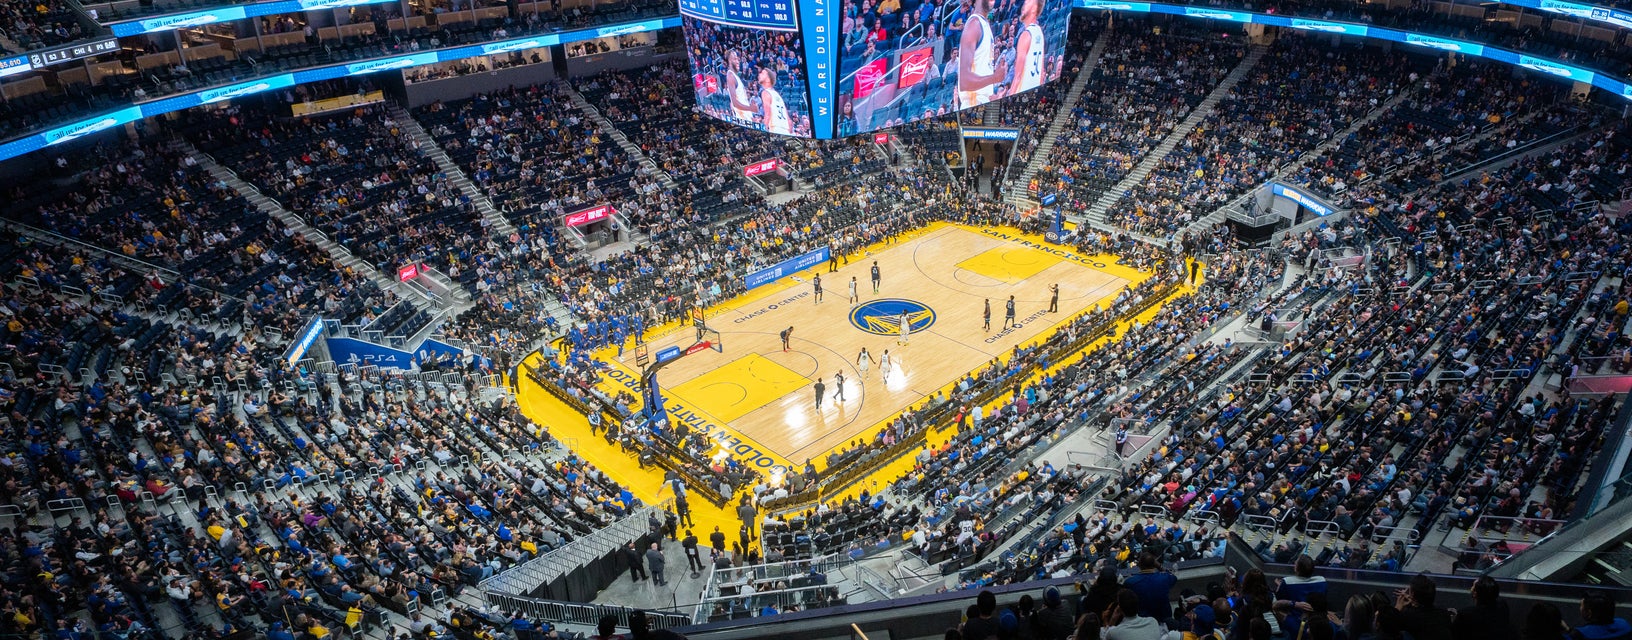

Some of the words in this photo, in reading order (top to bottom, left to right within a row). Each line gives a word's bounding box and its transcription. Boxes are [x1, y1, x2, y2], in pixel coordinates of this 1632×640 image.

[816, 25, 825, 54] DUB
[817, 62, 826, 89] ARE
[818, 97, 828, 116] WE
[985, 131, 1018, 139] WARRIORS
[981, 228, 1011, 240] SAN
[1013, 238, 1107, 268] FRANCISCO
[756, 270, 775, 280] UNITED
[734, 308, 770, 324] CHASE
[778, 291, 809, 306] CENTER
[984, 327, 1015, 344] CHASE
[1021, 309, 1047, 325] CENTER
[666, 404, 716, 433] STATE
[711, 430, 788, 476] GOLDEN
